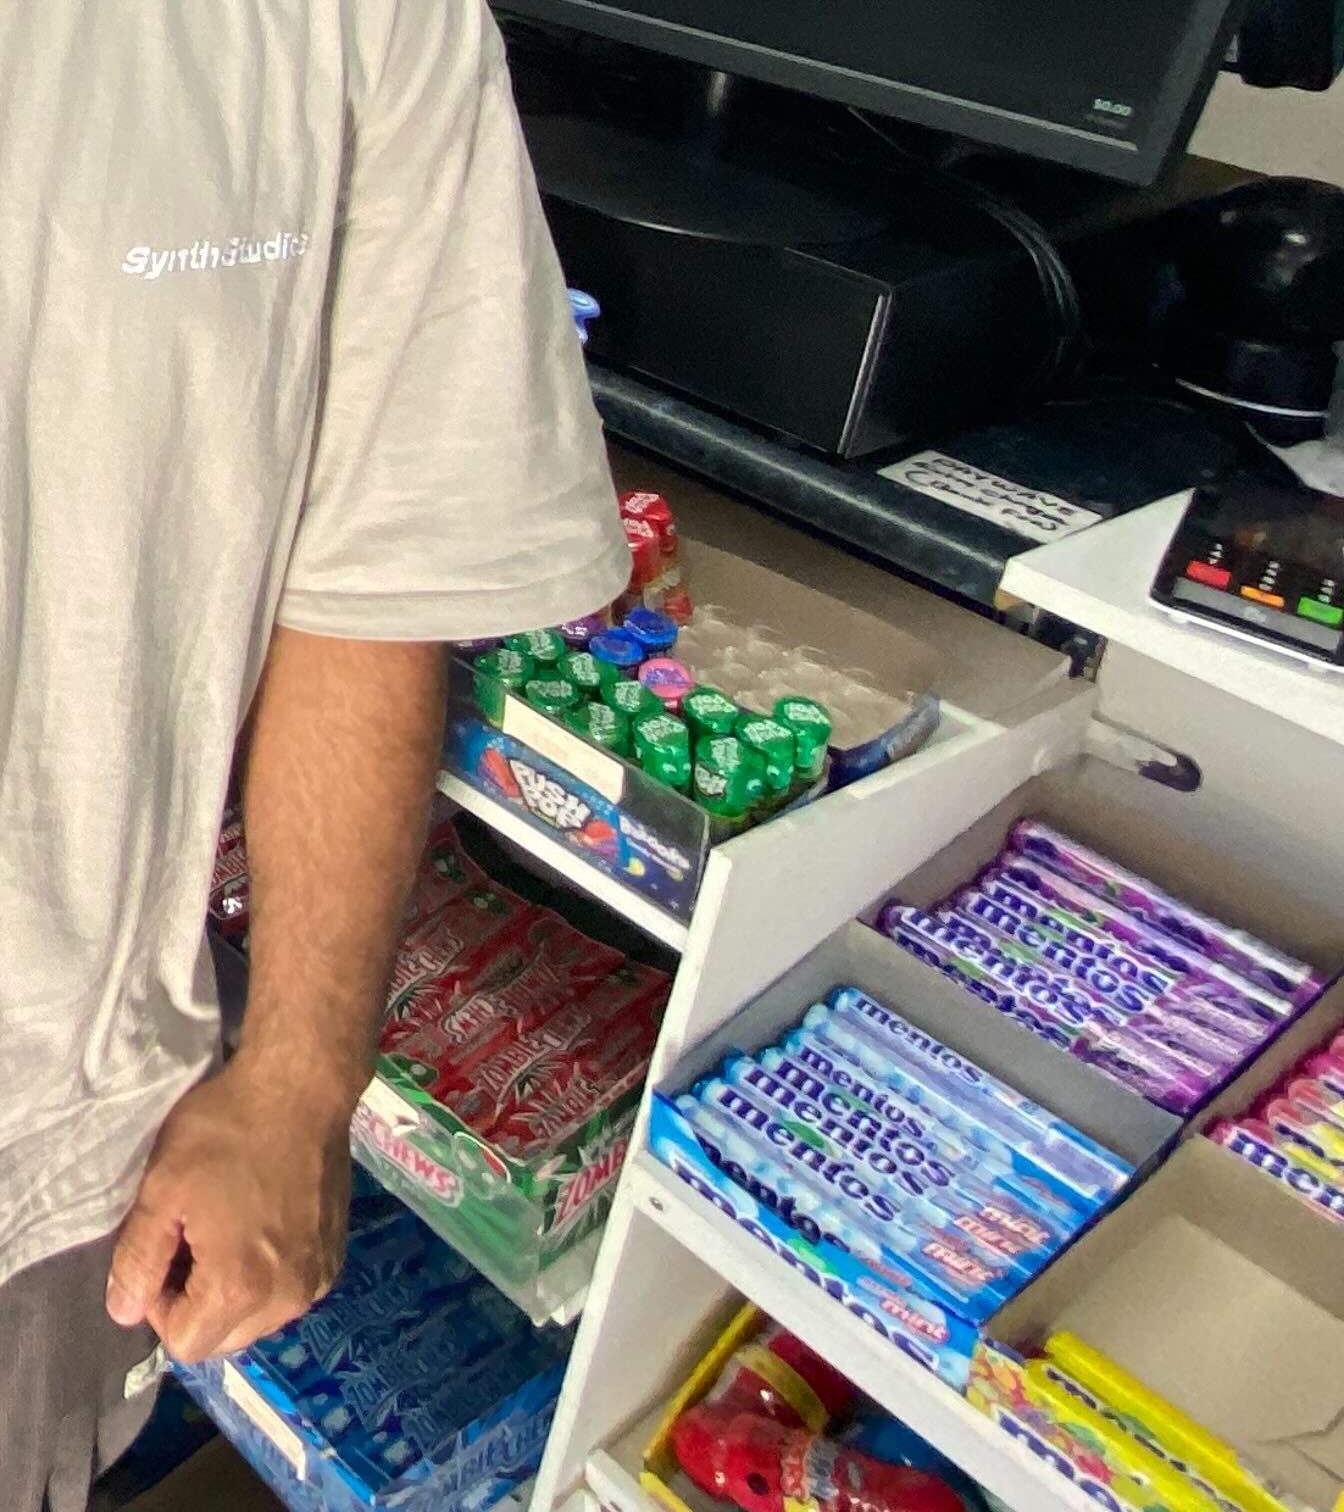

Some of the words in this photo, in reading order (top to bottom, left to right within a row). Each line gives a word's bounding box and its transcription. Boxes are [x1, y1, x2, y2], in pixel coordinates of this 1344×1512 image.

[798, 1047, 927, 1139] mentos
[854, 997, 983, 1085] mentos
[717, 1086, 901, 1223] mentos
[743, 1067, 926, 1197] mentos
[776, 1060, 956, 1188] mentos
[880, 1297, 949, 1341] mint
